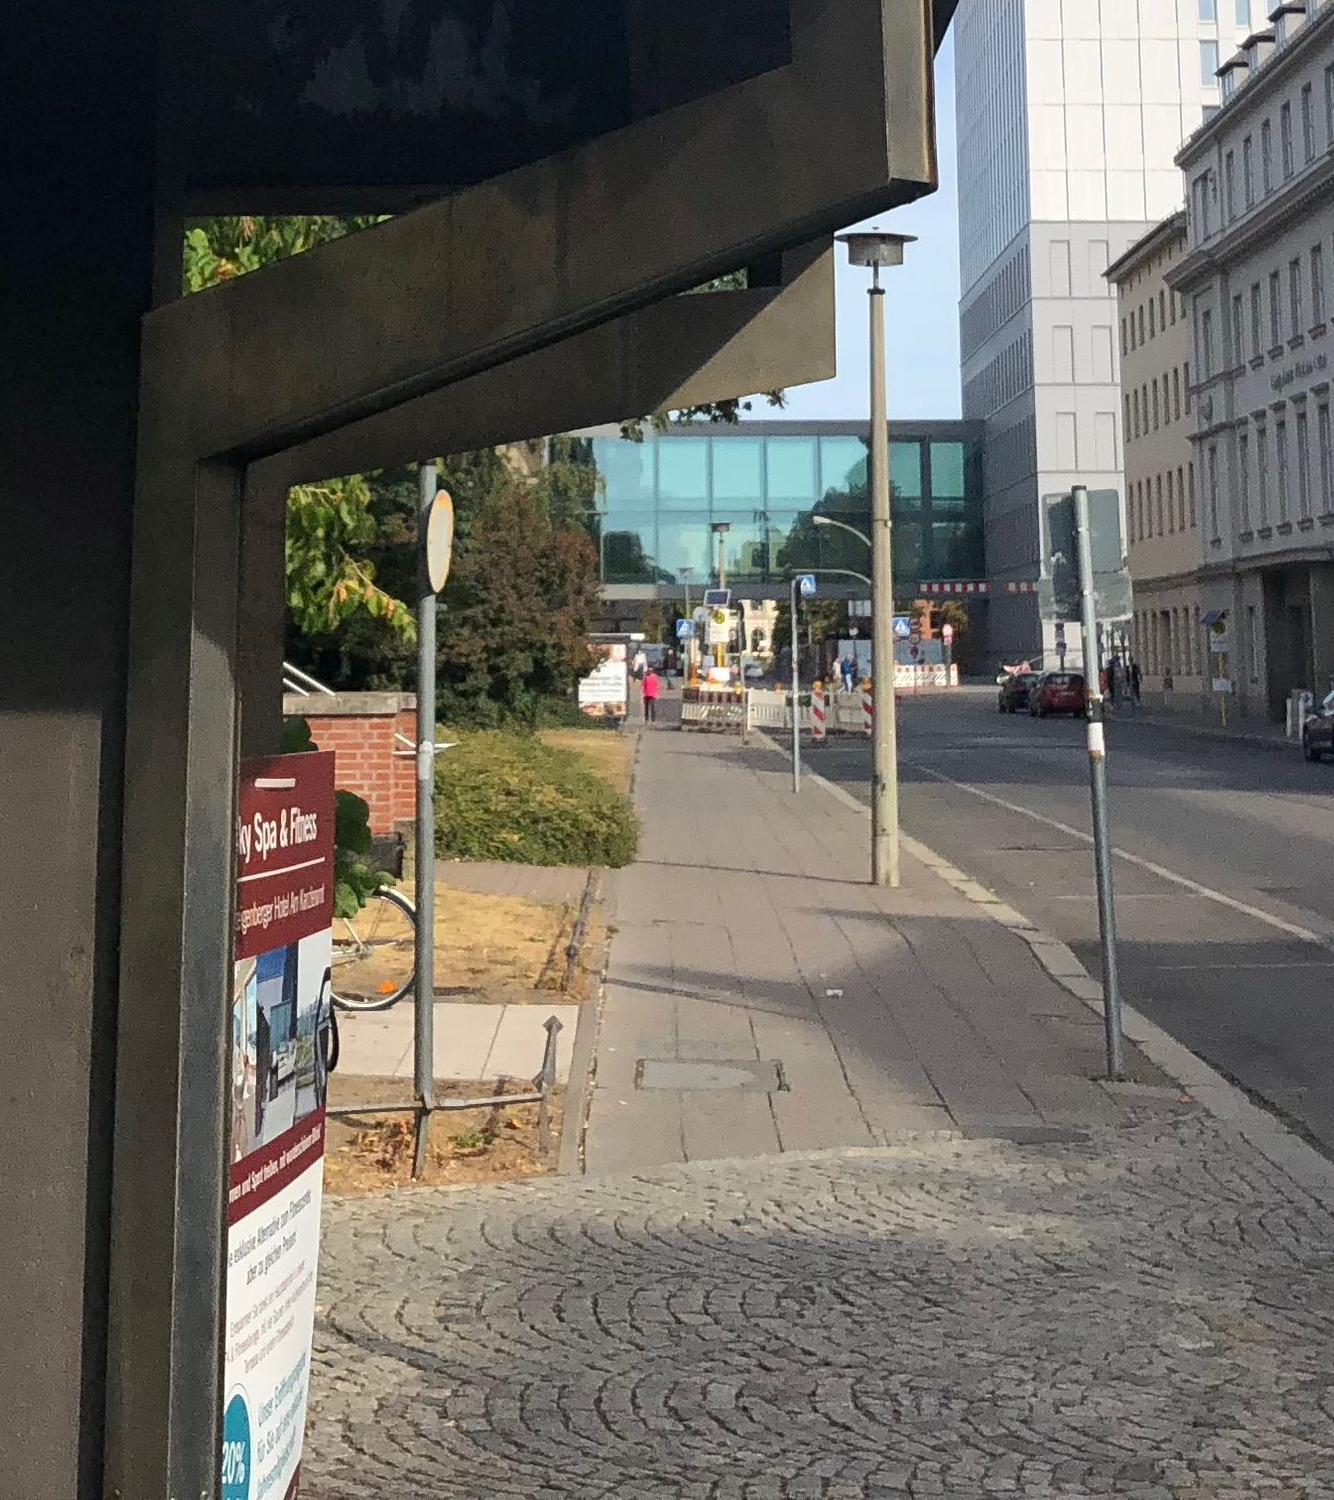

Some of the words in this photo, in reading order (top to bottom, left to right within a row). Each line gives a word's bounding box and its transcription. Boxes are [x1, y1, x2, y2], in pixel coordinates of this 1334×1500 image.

[237, 814, 252, 864] ky
[253, 811, 277, 861] Spa
[279, 808, 289, 848] &
[290, 806, 318, 845] Fitness
